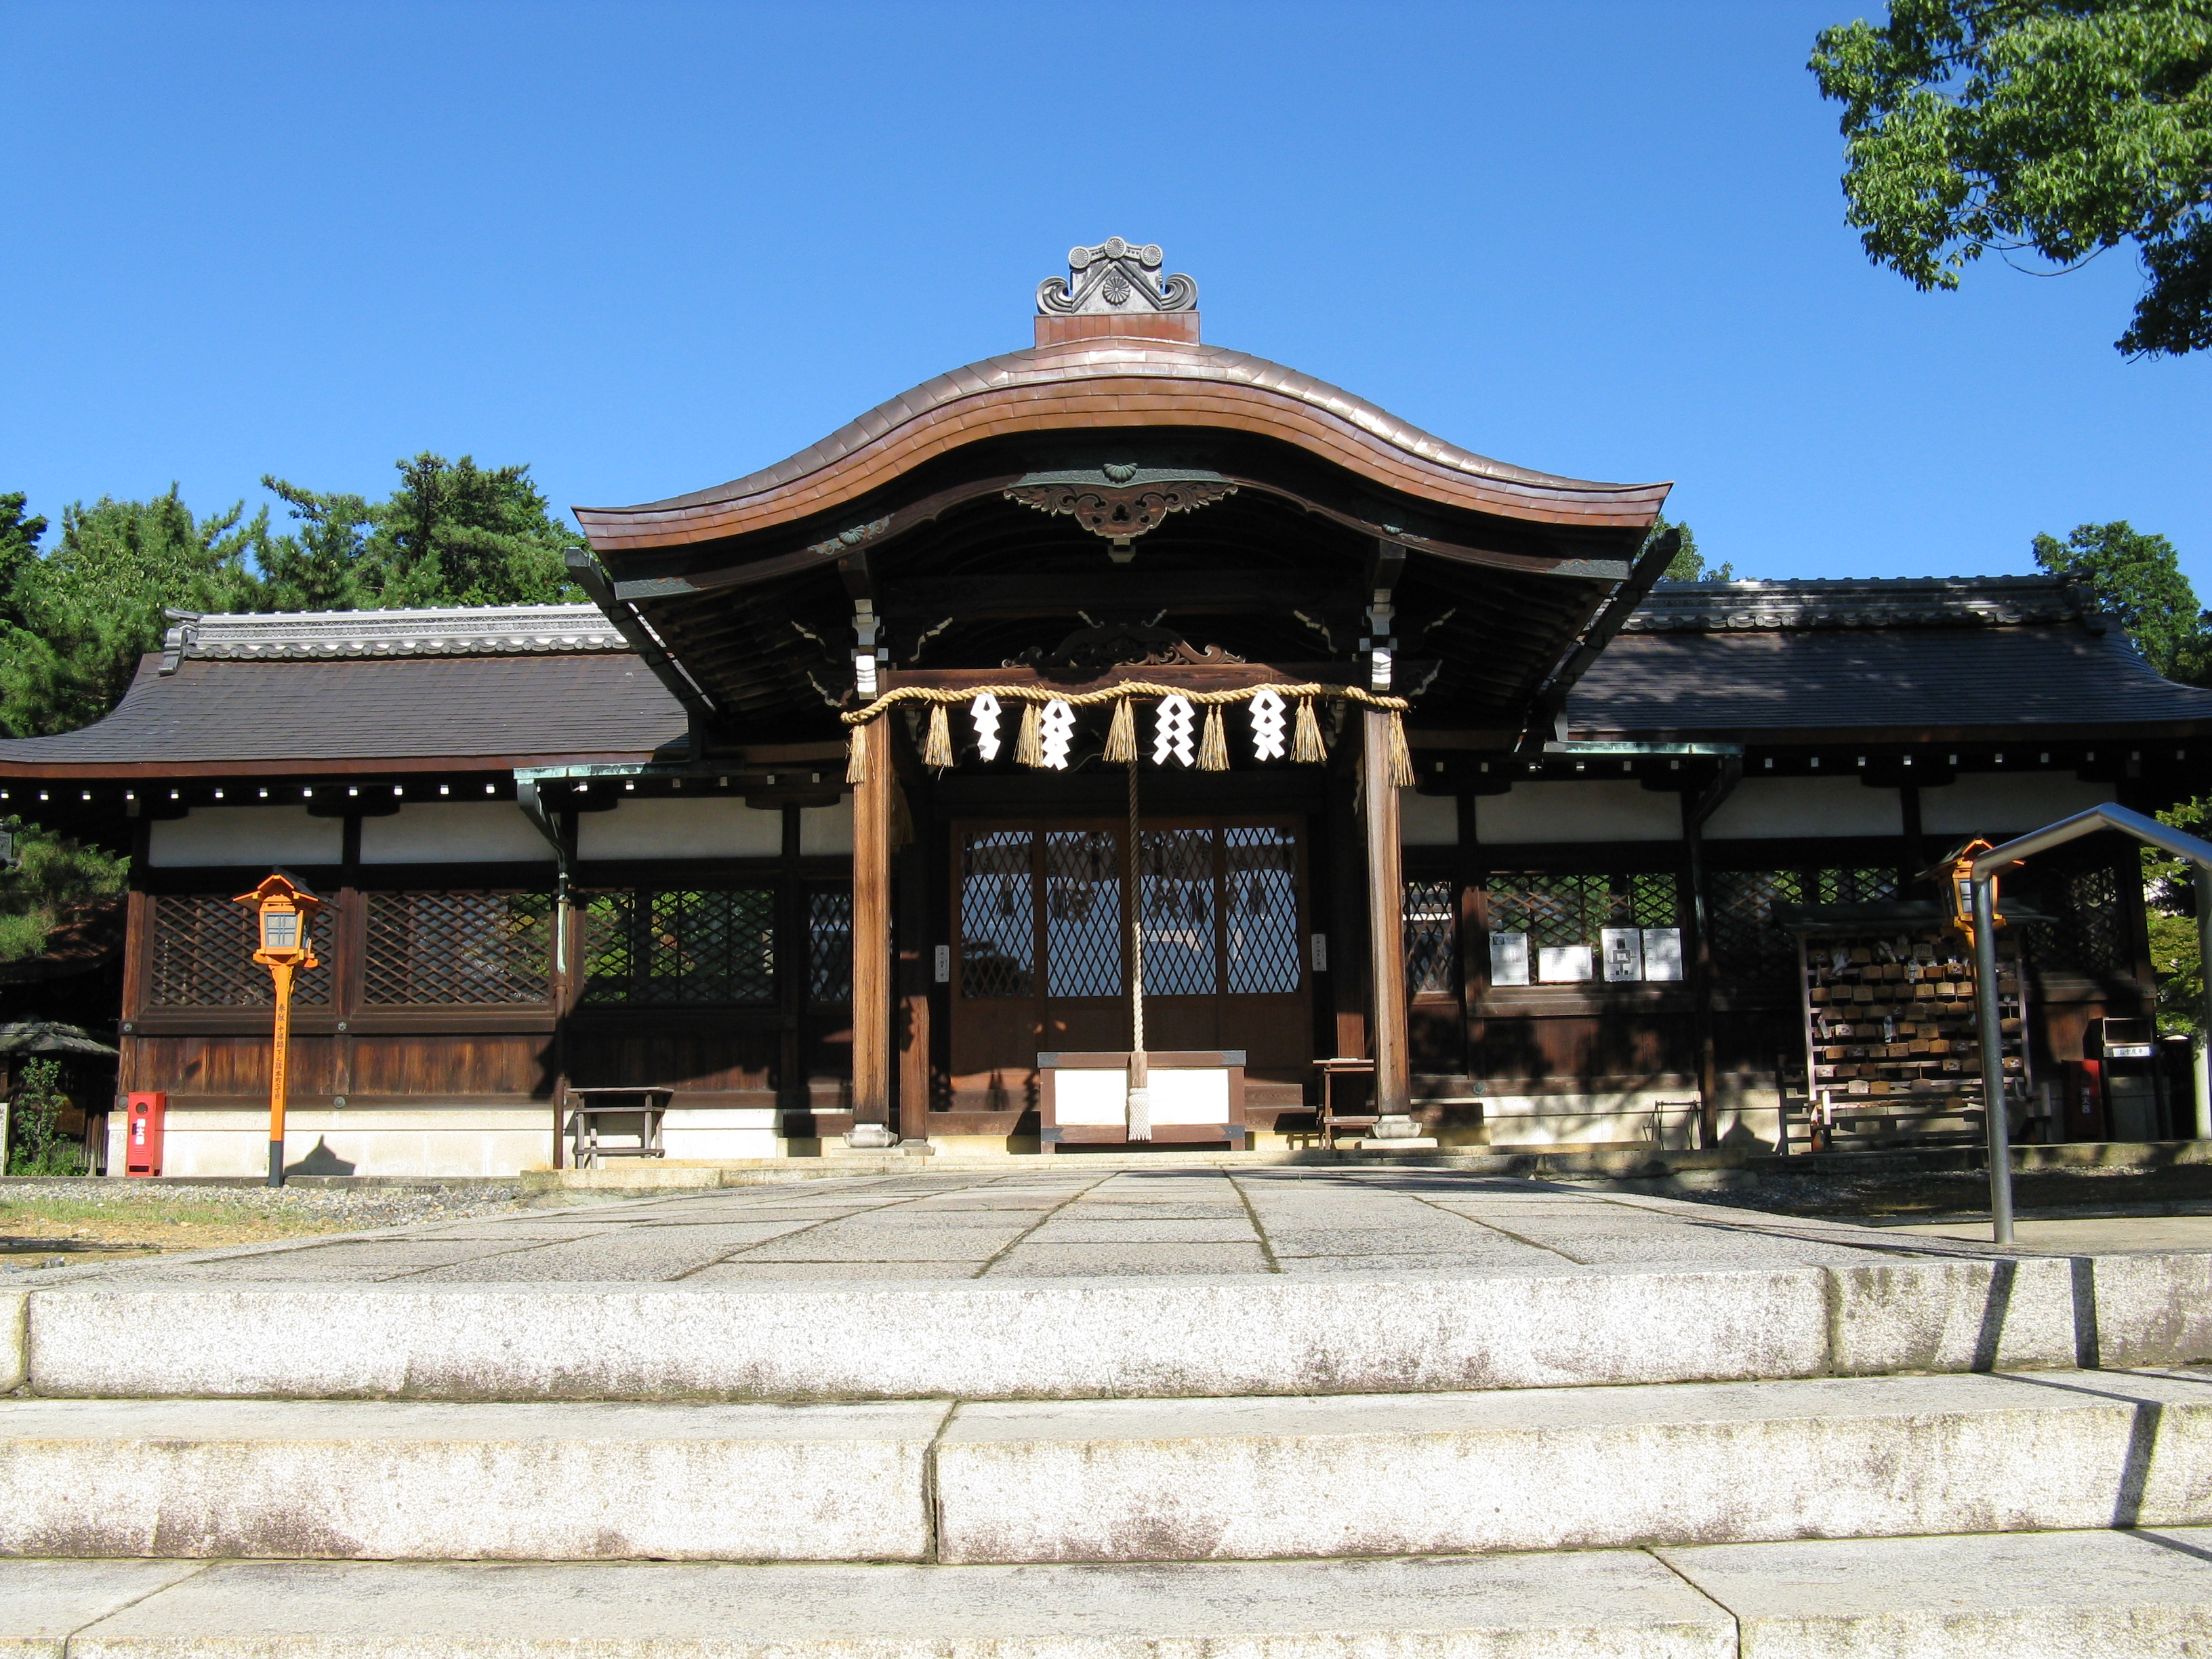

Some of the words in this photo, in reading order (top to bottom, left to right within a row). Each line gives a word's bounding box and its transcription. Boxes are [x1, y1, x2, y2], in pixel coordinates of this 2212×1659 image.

[2081, 1086, 2090, 1113] 消火器
[136, 1118, 146, 1145] 消火器
